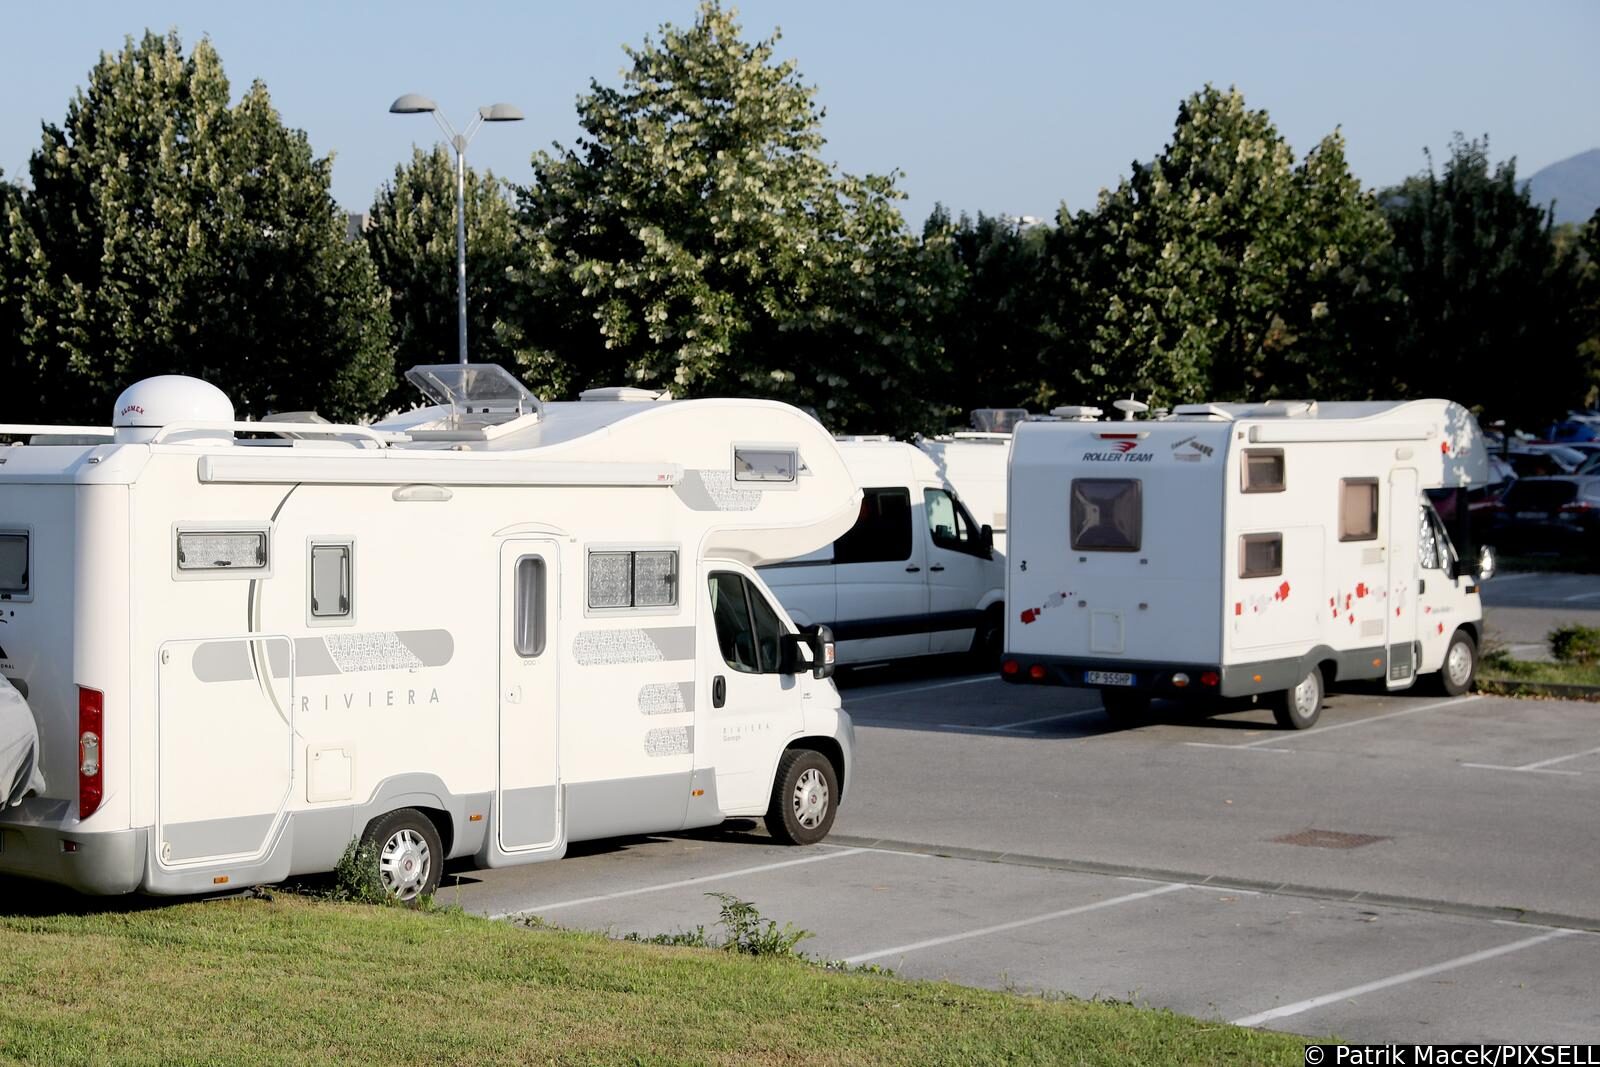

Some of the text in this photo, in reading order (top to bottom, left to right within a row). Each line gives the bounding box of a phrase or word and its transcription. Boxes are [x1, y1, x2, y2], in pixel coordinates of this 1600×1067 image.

[1082, 452, 1153, 462] ROLLER TEAM
[301, 687, 440, 712] RIVIERA
